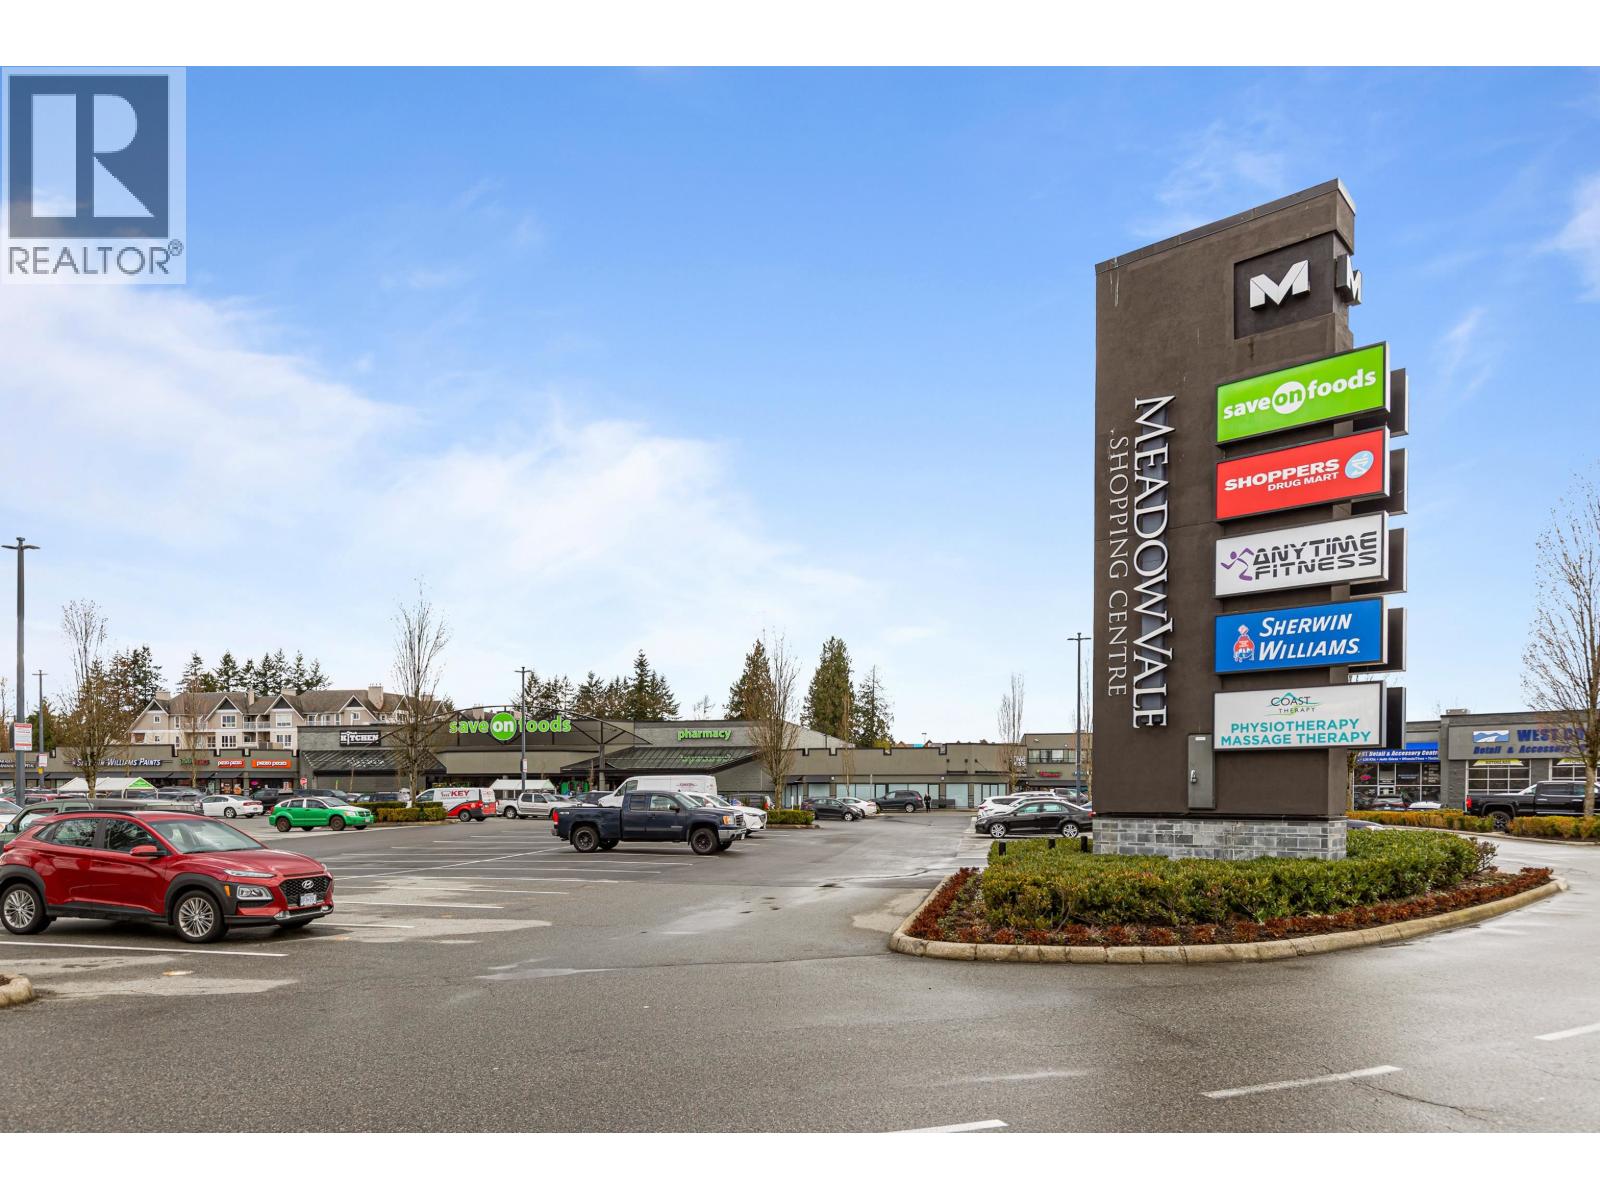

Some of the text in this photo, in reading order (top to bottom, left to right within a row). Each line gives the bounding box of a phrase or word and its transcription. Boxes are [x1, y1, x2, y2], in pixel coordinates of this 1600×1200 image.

[1250, 260, 1310, 309] M
[1223, 368, 1377, 420] save on foods
[1224, 458, 1340, 491] SHOPPERS
[1267, 471, 1340, 492] DRUG MART
[1253, 531, 1377, 566] ANYTIME
[1108, 436, 1129, 697] SHOPPING CENTRE
[1133, 395, 1176, 729] MEADOWVALE
[1255, 550, 1377, 580] FITNESS
[1259, 613, 1353, 638] SHERWIN
[1258, 638, 1361, 661] WILLIAMS
[1270, 696, 1311, 707] COAST
[448, 720, 489, 733] save
[492, 721, 514, 732] on
[677, 728, 732, 741] pharmacy
[1231, 718, 1360, 734] PHYSIOTHERAPY
[1517, 728, 1558, 741] WEST
[340, 733, 379, 742] KITCHEN
[1221, 731, 1372, 746] MASSAGE THERAPY
[1473, 746, 1502, 755] Detail
[139, 757, 161, 766] PAINTS
